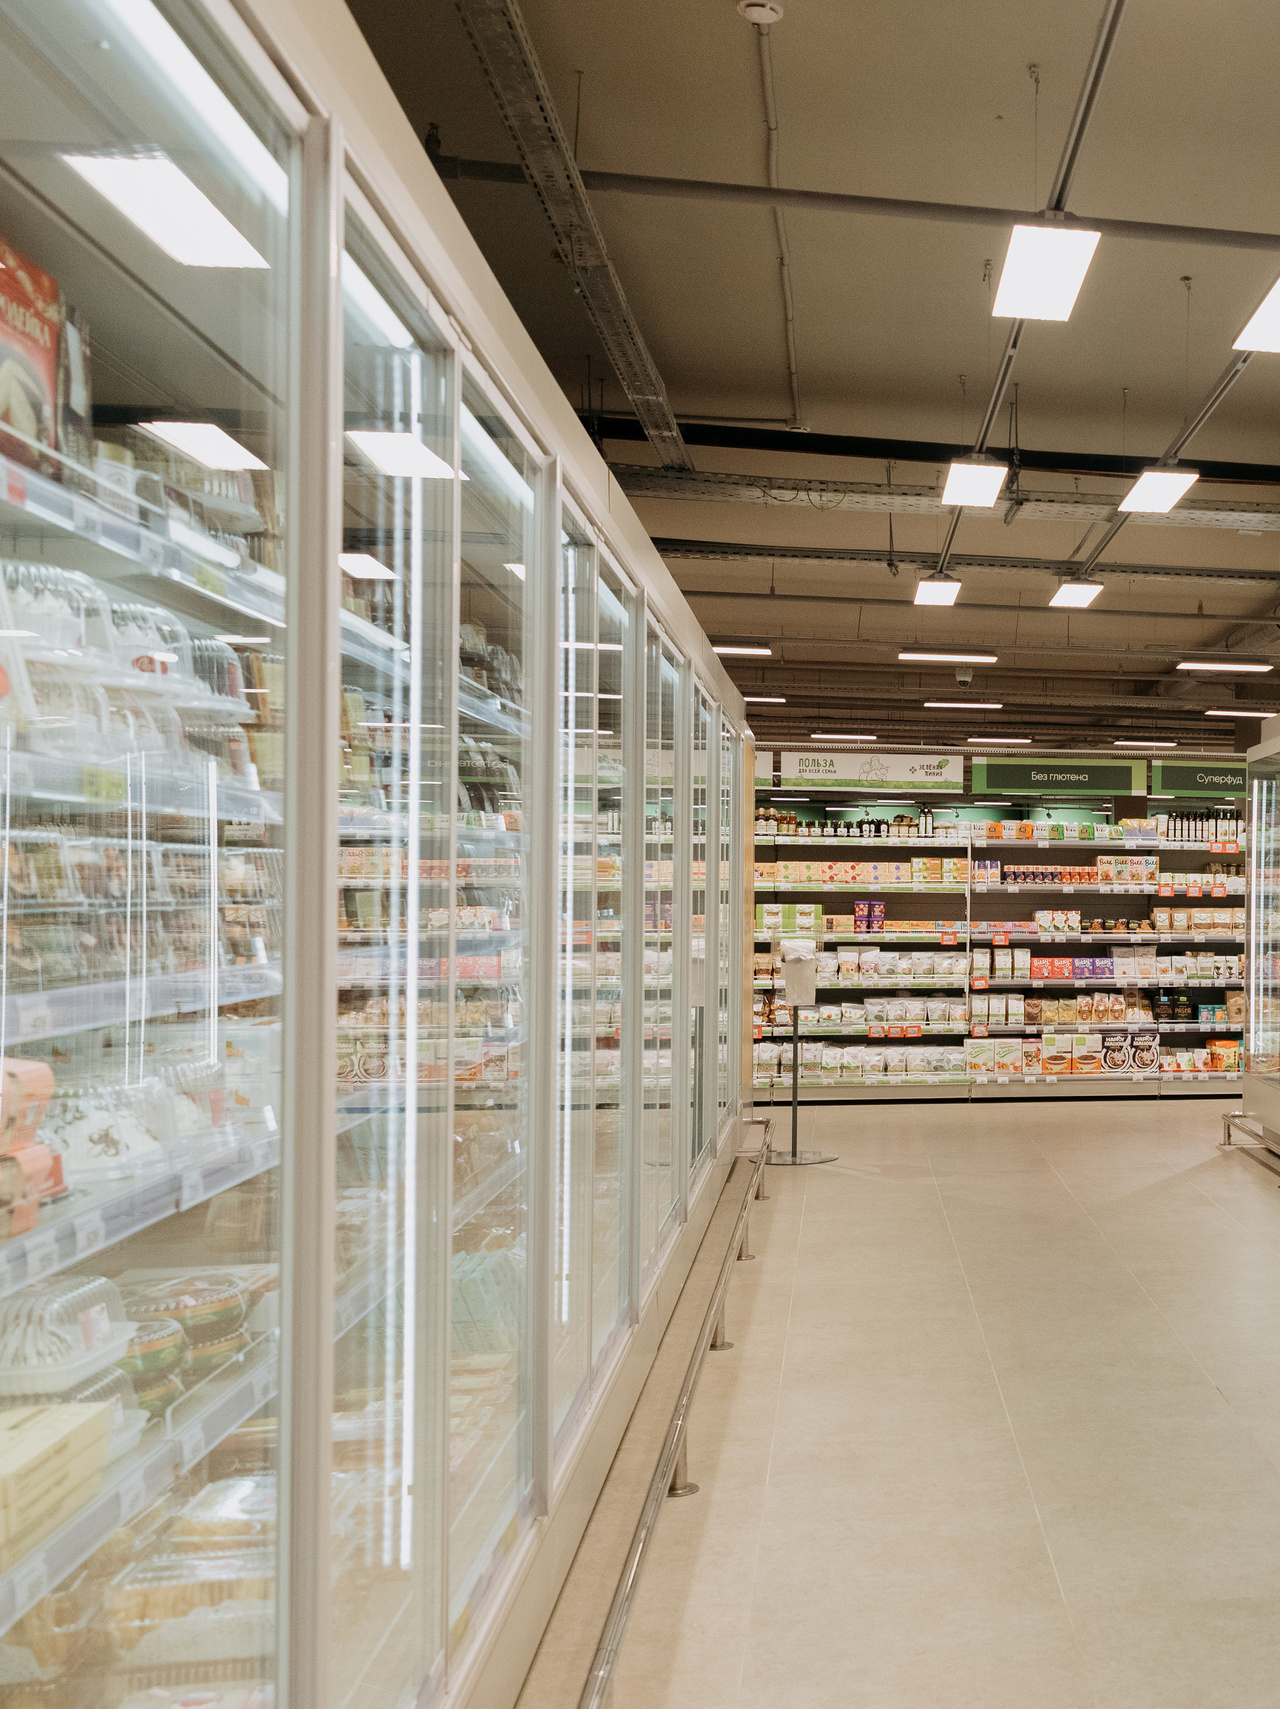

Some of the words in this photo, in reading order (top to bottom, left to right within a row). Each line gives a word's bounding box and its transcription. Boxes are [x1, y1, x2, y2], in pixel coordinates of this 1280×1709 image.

[798, 758, 835, 769] ПОЛЬЗА
[1031, 771, 1049, 781] Без
[1049, 773, 1089, 783] глютена
